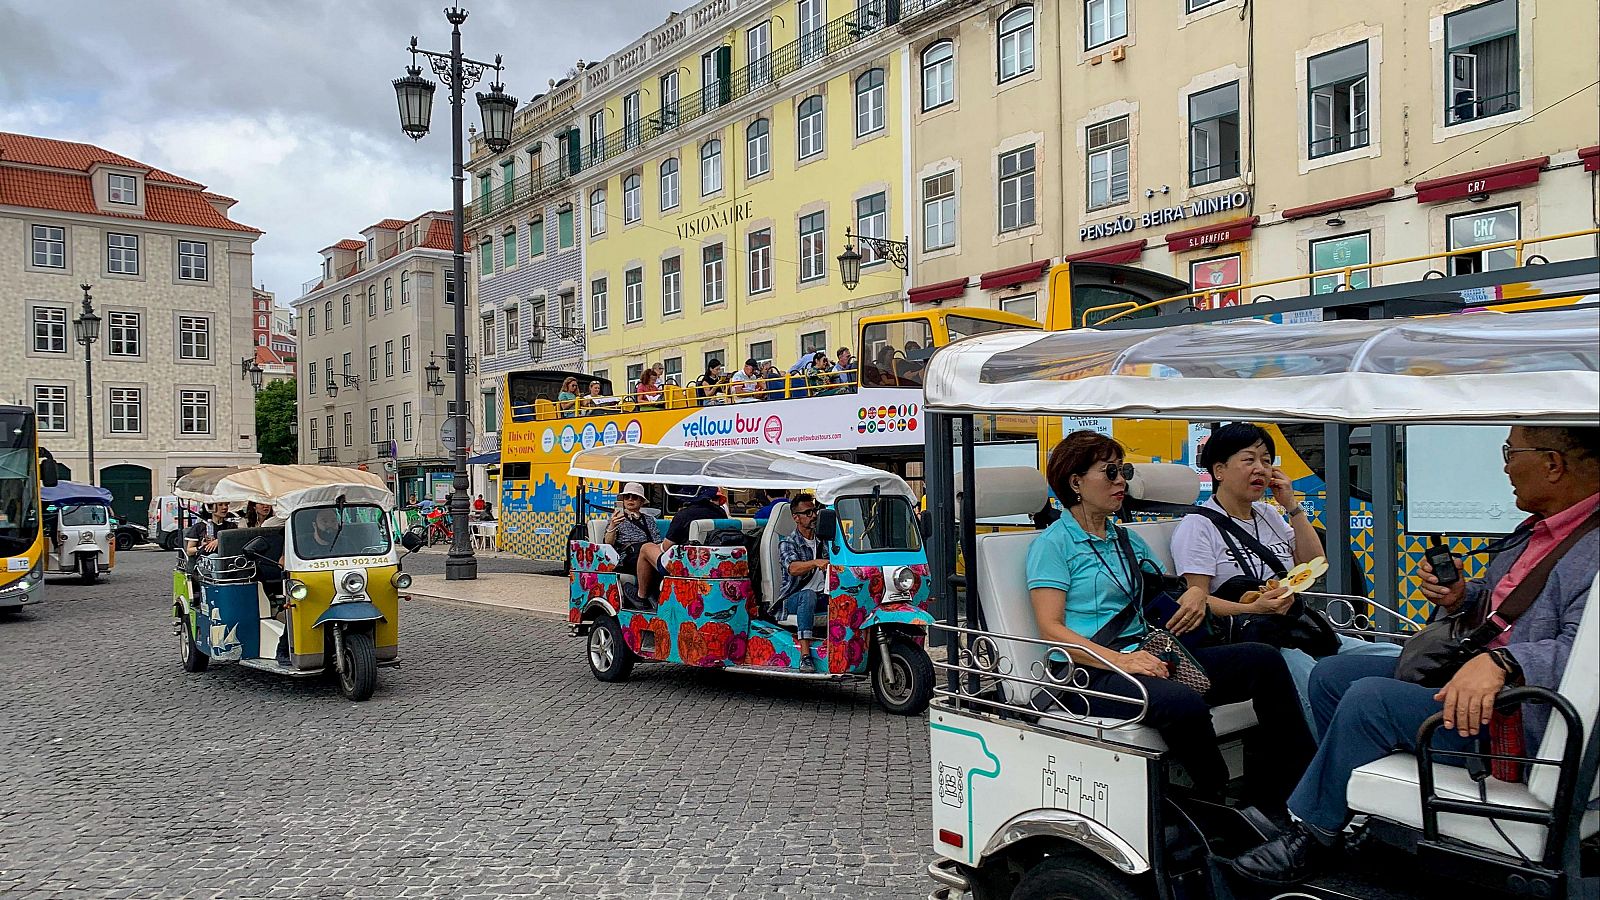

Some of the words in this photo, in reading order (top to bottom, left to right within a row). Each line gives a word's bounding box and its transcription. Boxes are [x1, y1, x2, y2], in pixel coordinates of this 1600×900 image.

[1468, 180, 1486, 193] CR7
[676, 200, 753, 240] VISIONAIRE
[1078, 215, 1134, 241] PENSÃO
[1141, 205, 1184, 227] BEIRA
[1191, 192, 1246, 217] MINHO
[1473, 216, 1497, 237] CR7
[1200, 231, 1230, 244] BENFICA
[682, 415, 733, 438] yellow
[735, 412, 762, 433] bus
[1078, 419, 1098, 427] VIVER
[508, 431, 522, 442] This
[523, 430, 536, 443] city
[706, 437, 740, 447] SIGHTSEEING
[740, 436, 759, 445] TOURS
[785, 433, 842, 443] www.yellowbustours.com
[1350, 516, 1373, 527] RTO
[308, 561, 330, 569] +351
[332, 559, 349, 567] 931
